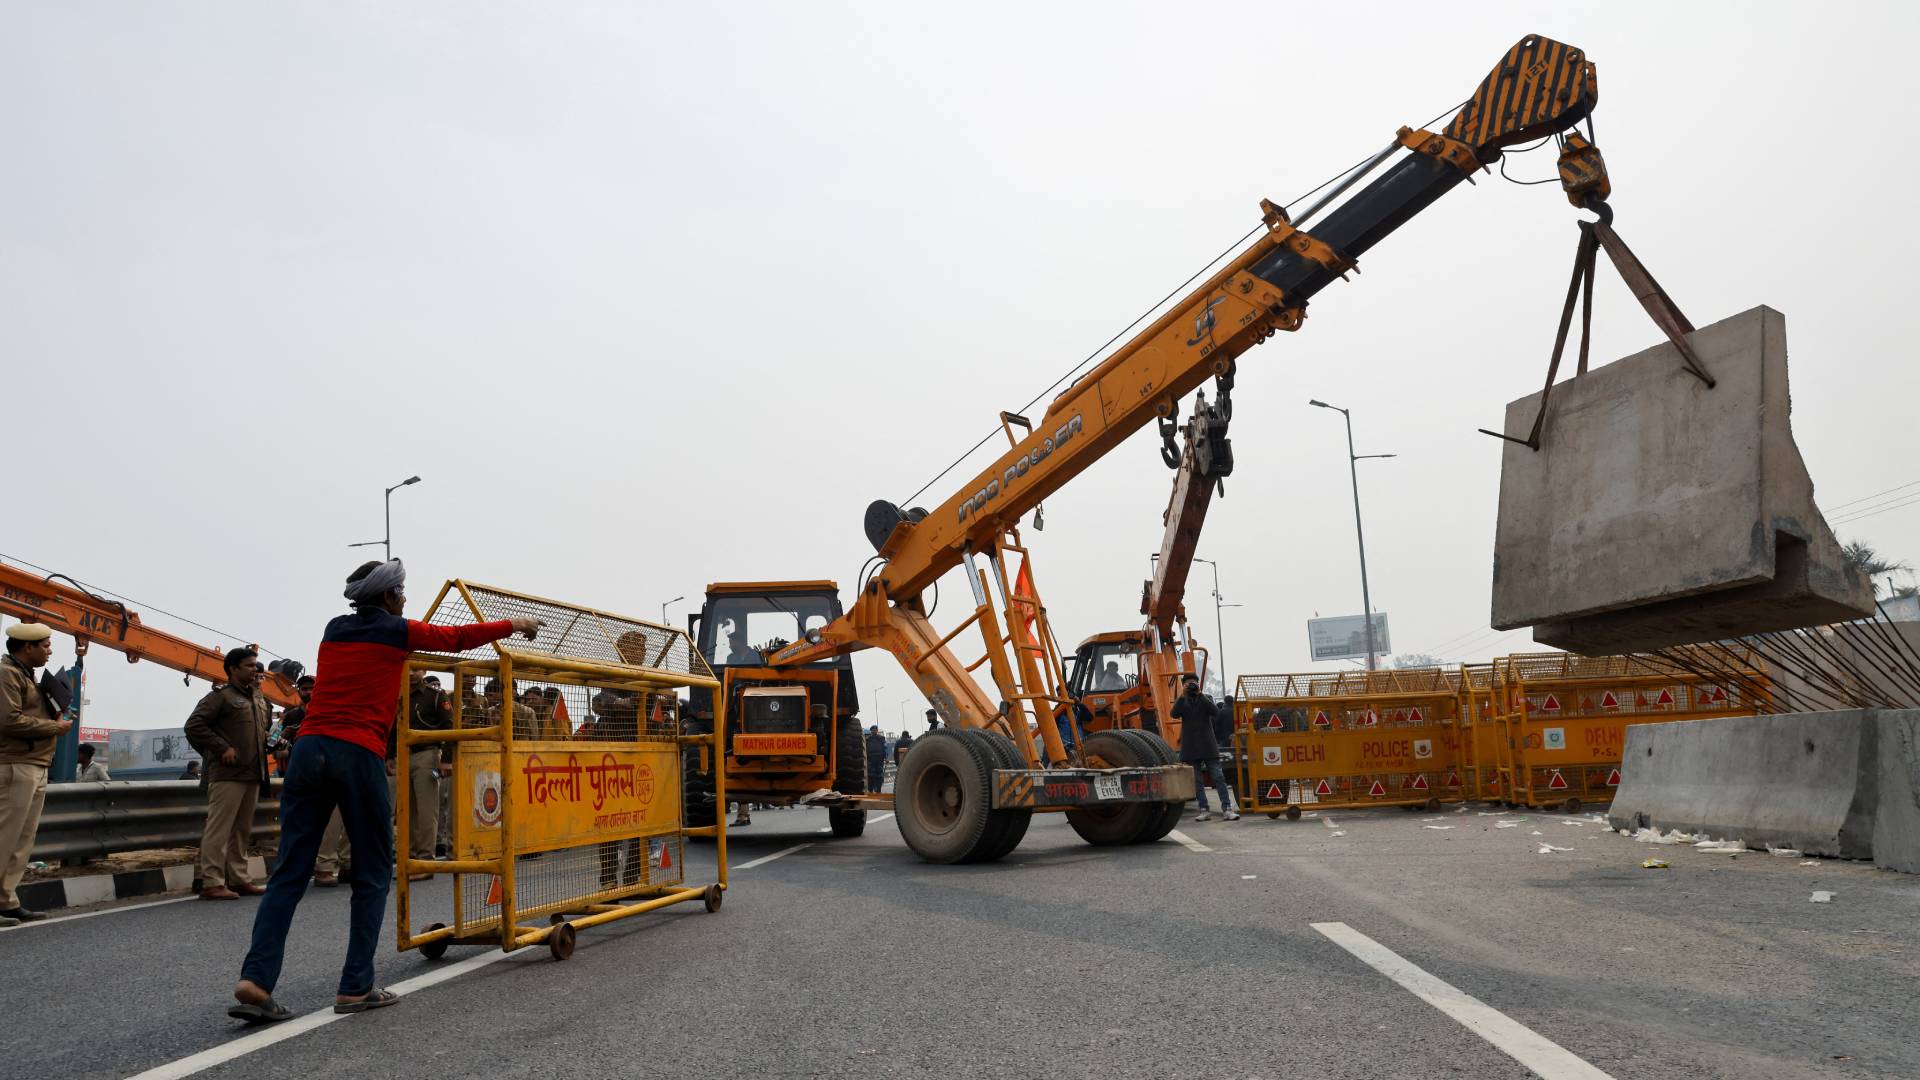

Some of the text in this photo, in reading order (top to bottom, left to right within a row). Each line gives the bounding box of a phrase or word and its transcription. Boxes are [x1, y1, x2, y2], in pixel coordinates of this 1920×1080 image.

[80, 608, 112, 635] ACE
[742, 736, 807, 750] MATHUR CRANES
[1286, 740, 1409, 762] DELHI POLICE
[1592, 747, 1617, 757] P.S.
[523, 752, 635, 811] दिल्ली पुलिस
